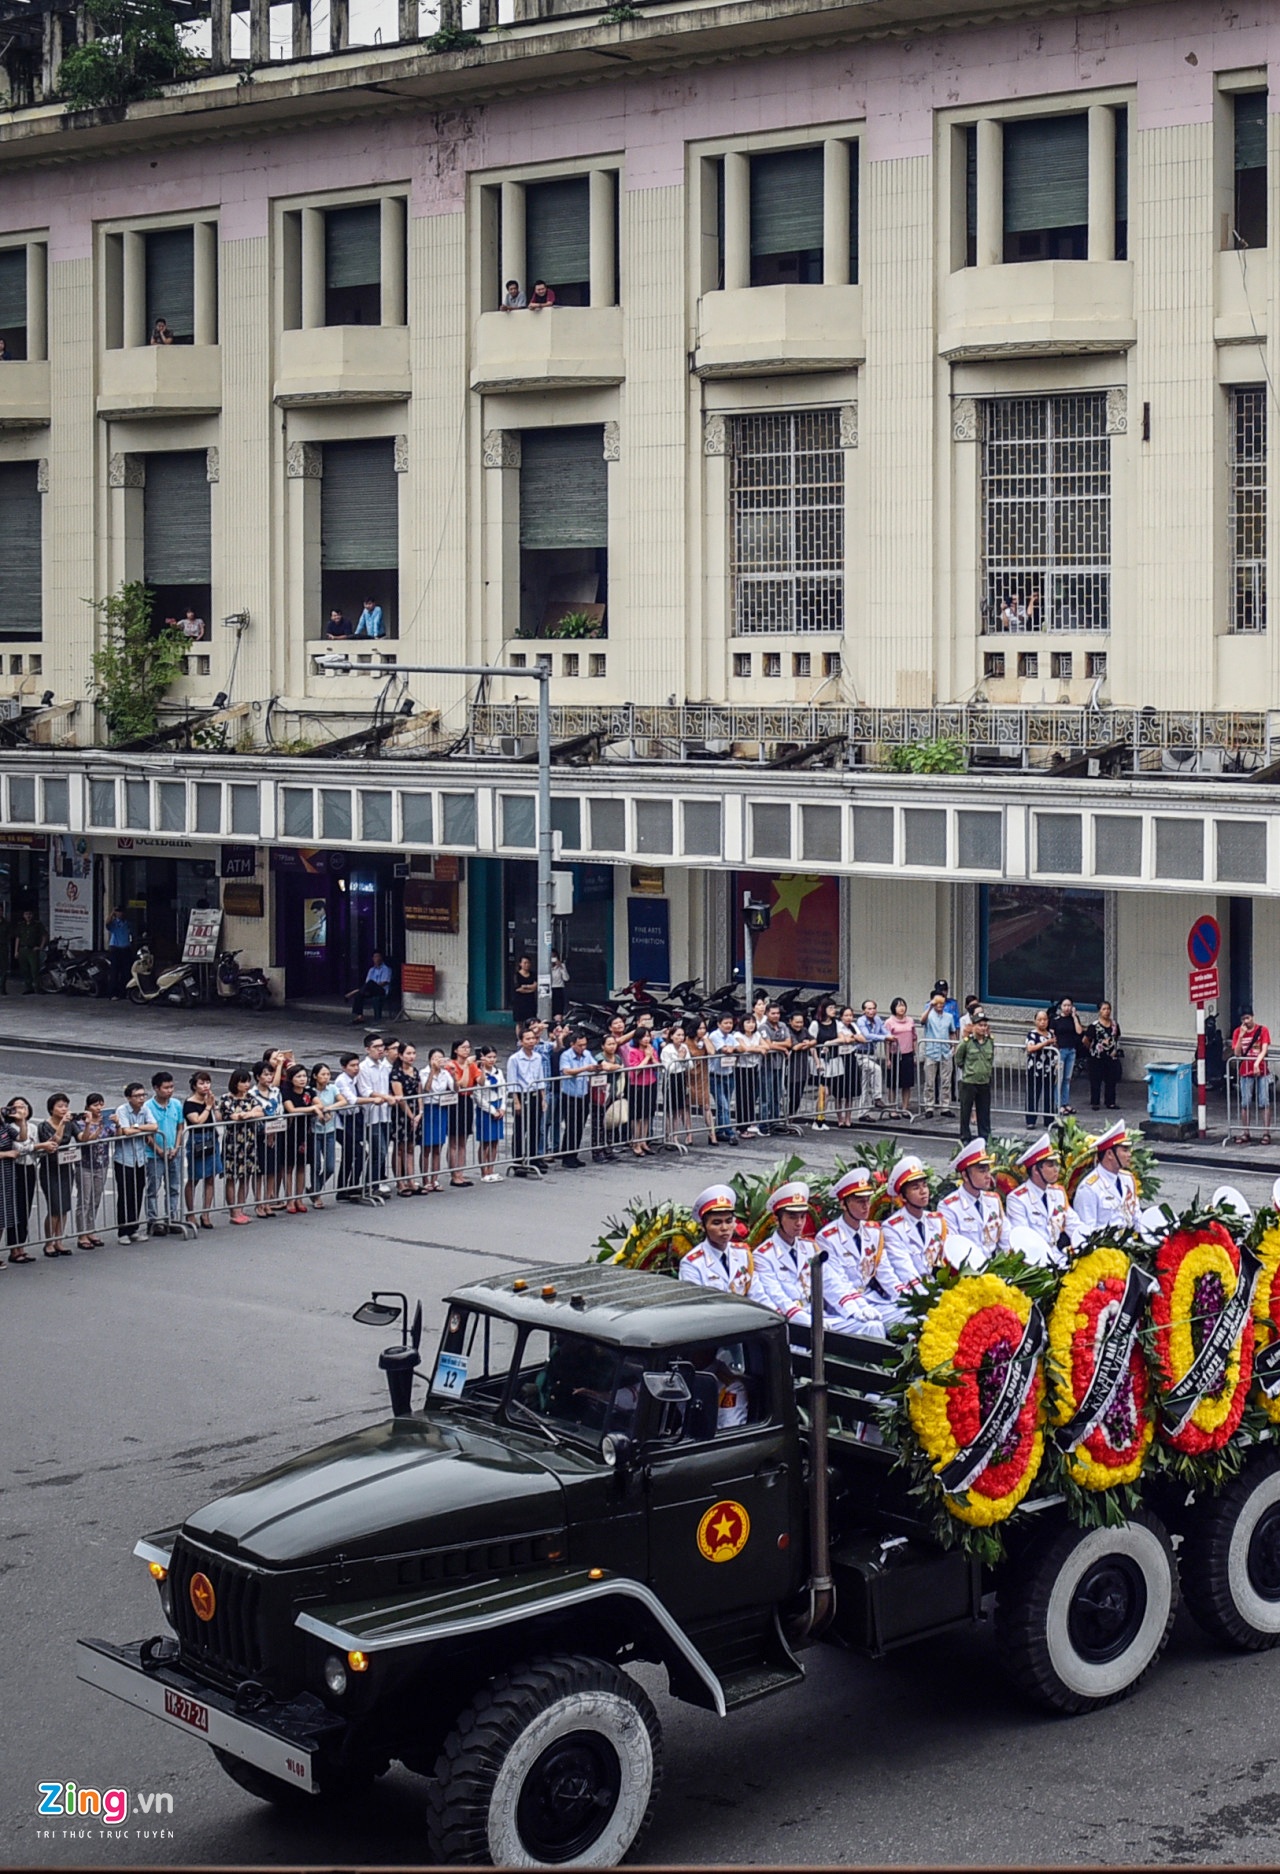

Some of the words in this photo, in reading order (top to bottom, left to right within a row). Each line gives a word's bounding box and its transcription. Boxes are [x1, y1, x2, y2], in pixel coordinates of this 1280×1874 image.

[226, 859, 251, 873] ATM
[632, 937, 665, 945] EXHIBITION
[1119, 1312, 1132, 1332] CAO
[443, 1370, 458, 1389] 12
[1194, 1353, 1223, 1391] KÍNH
